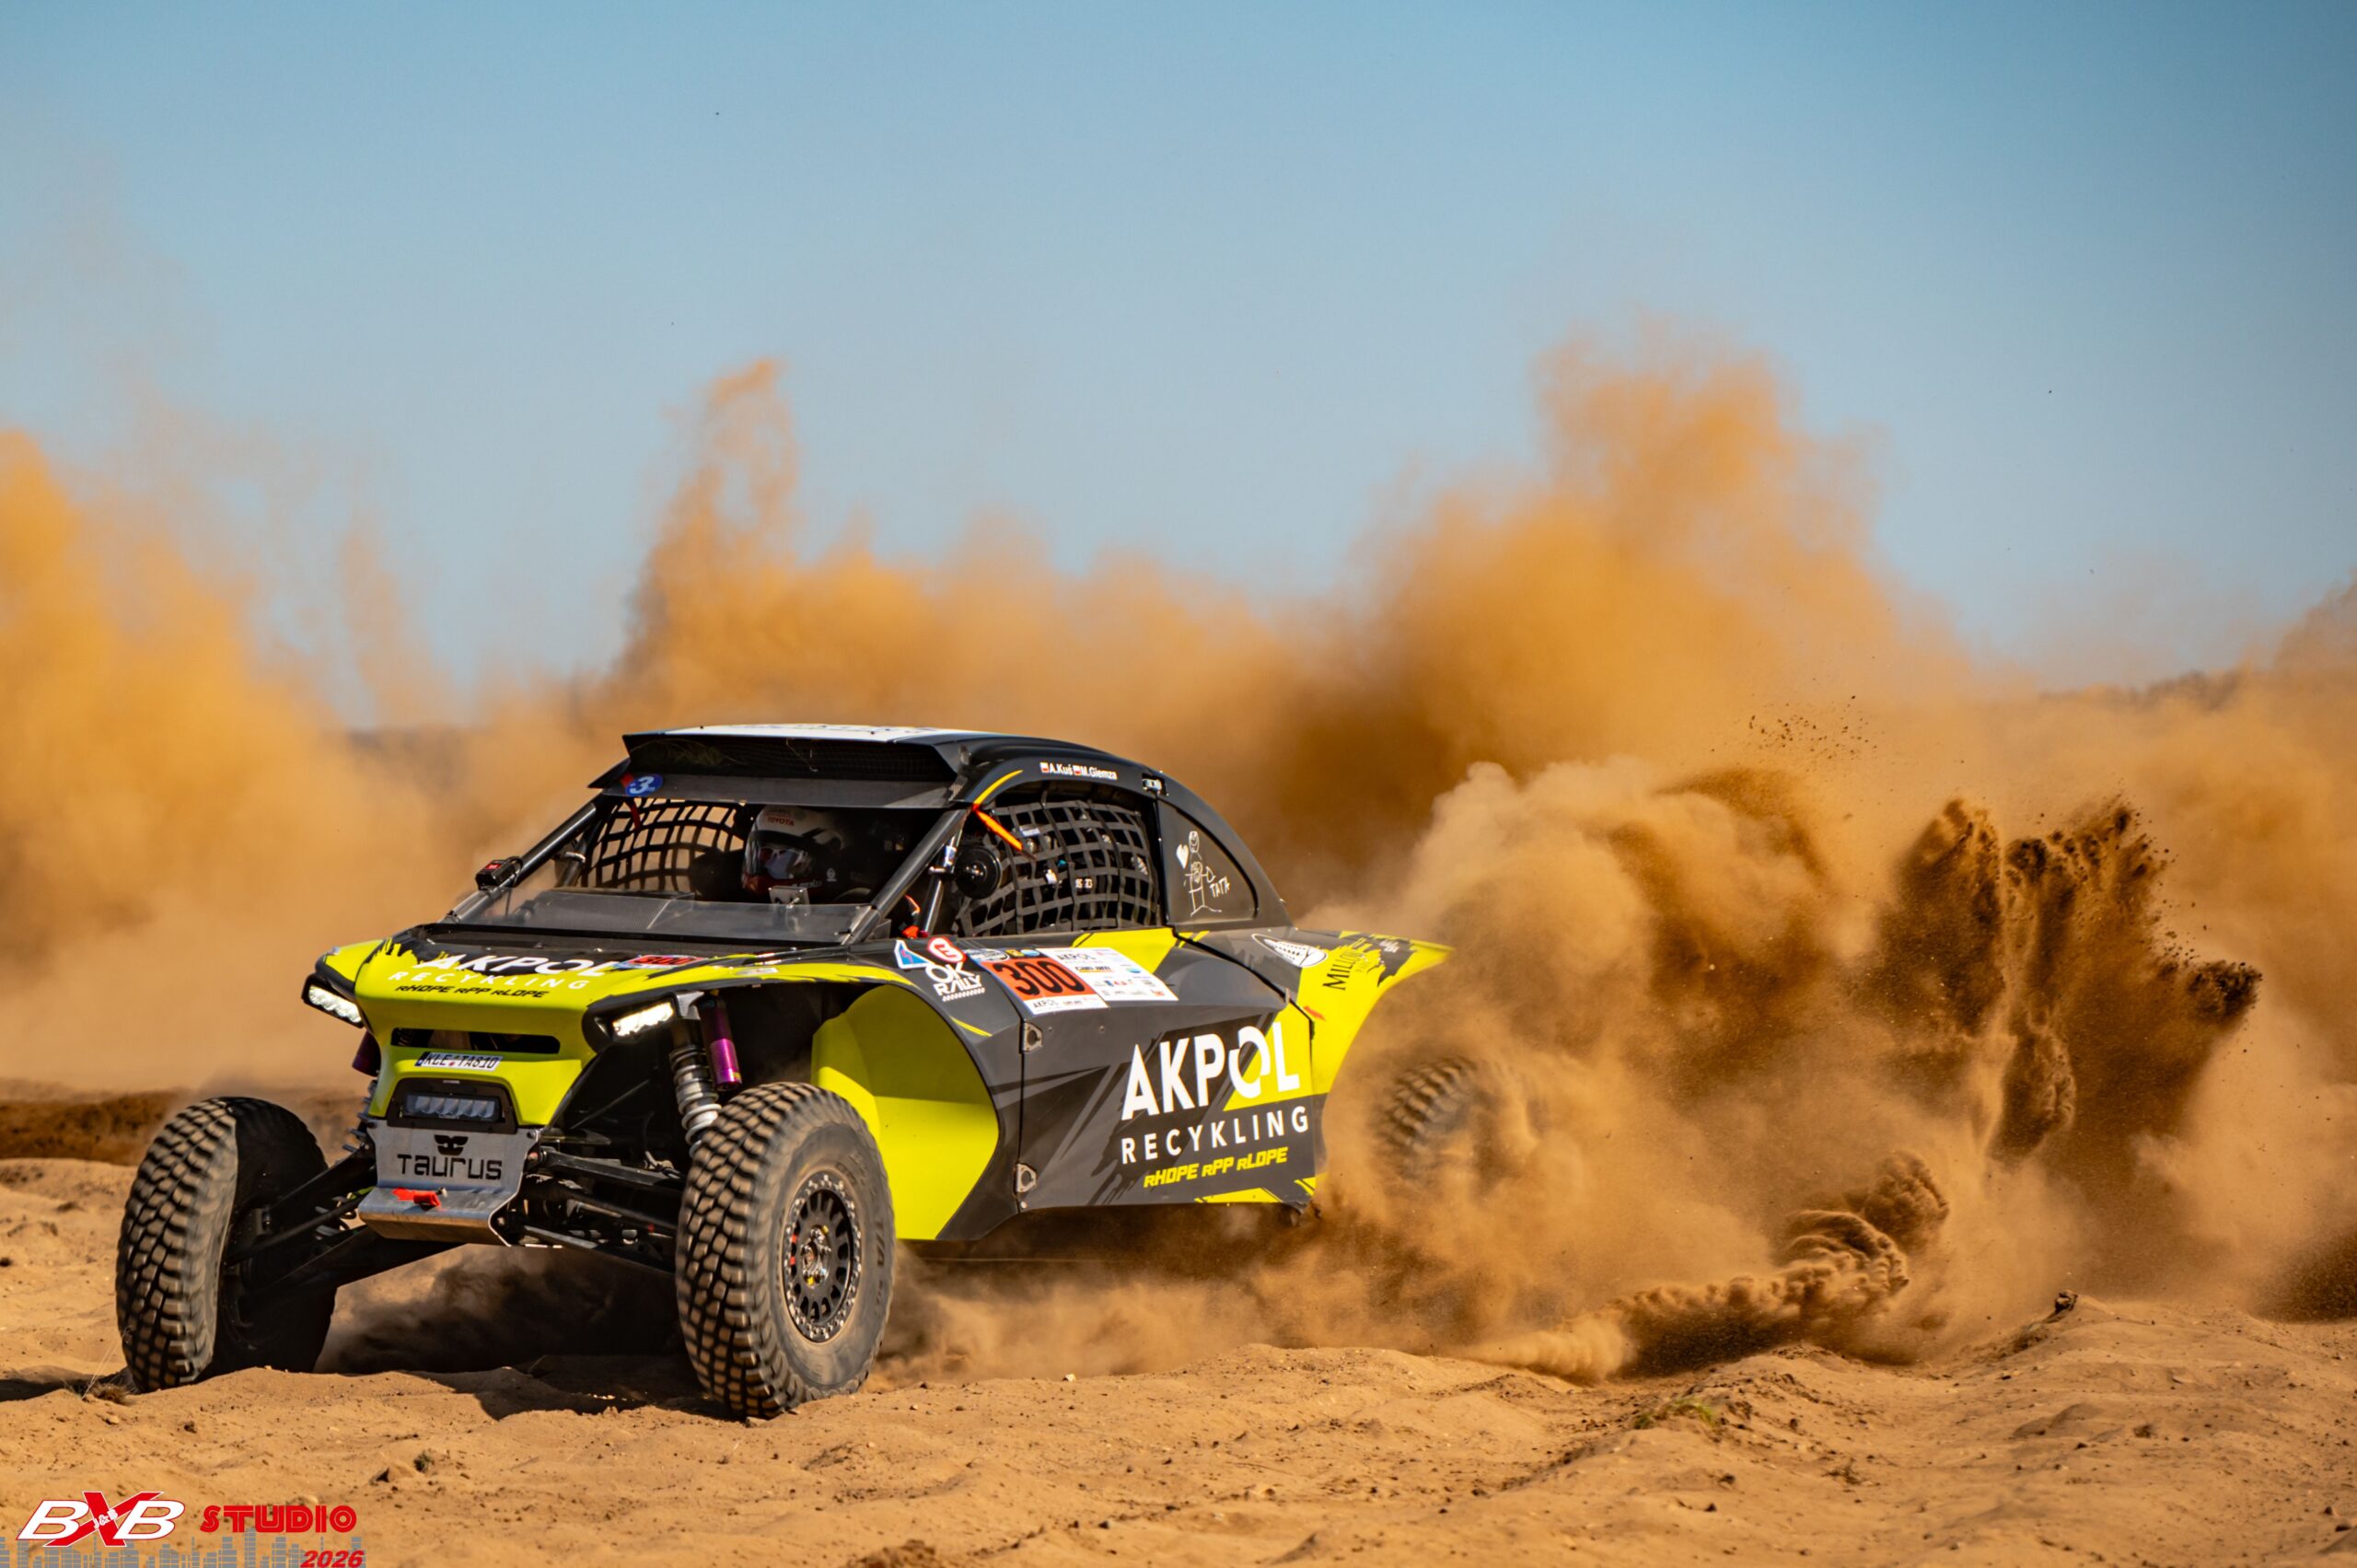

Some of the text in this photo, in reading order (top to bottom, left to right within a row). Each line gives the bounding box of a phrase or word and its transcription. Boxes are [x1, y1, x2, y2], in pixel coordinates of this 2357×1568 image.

[767, 817, 795, 827] TOYOTA
[412, 954, 620, 977] AKPOL
[925, 961, 975, 983] OK
[388, 971, 590, 990] RECYKLING
[934, 975, 981, 996] RALLY
[992, 960, 1086, 995] 300
[1121, 1021, 1301, 1121] AKPOL
[1121, 1106, 1309, 1165] RECYKLING
